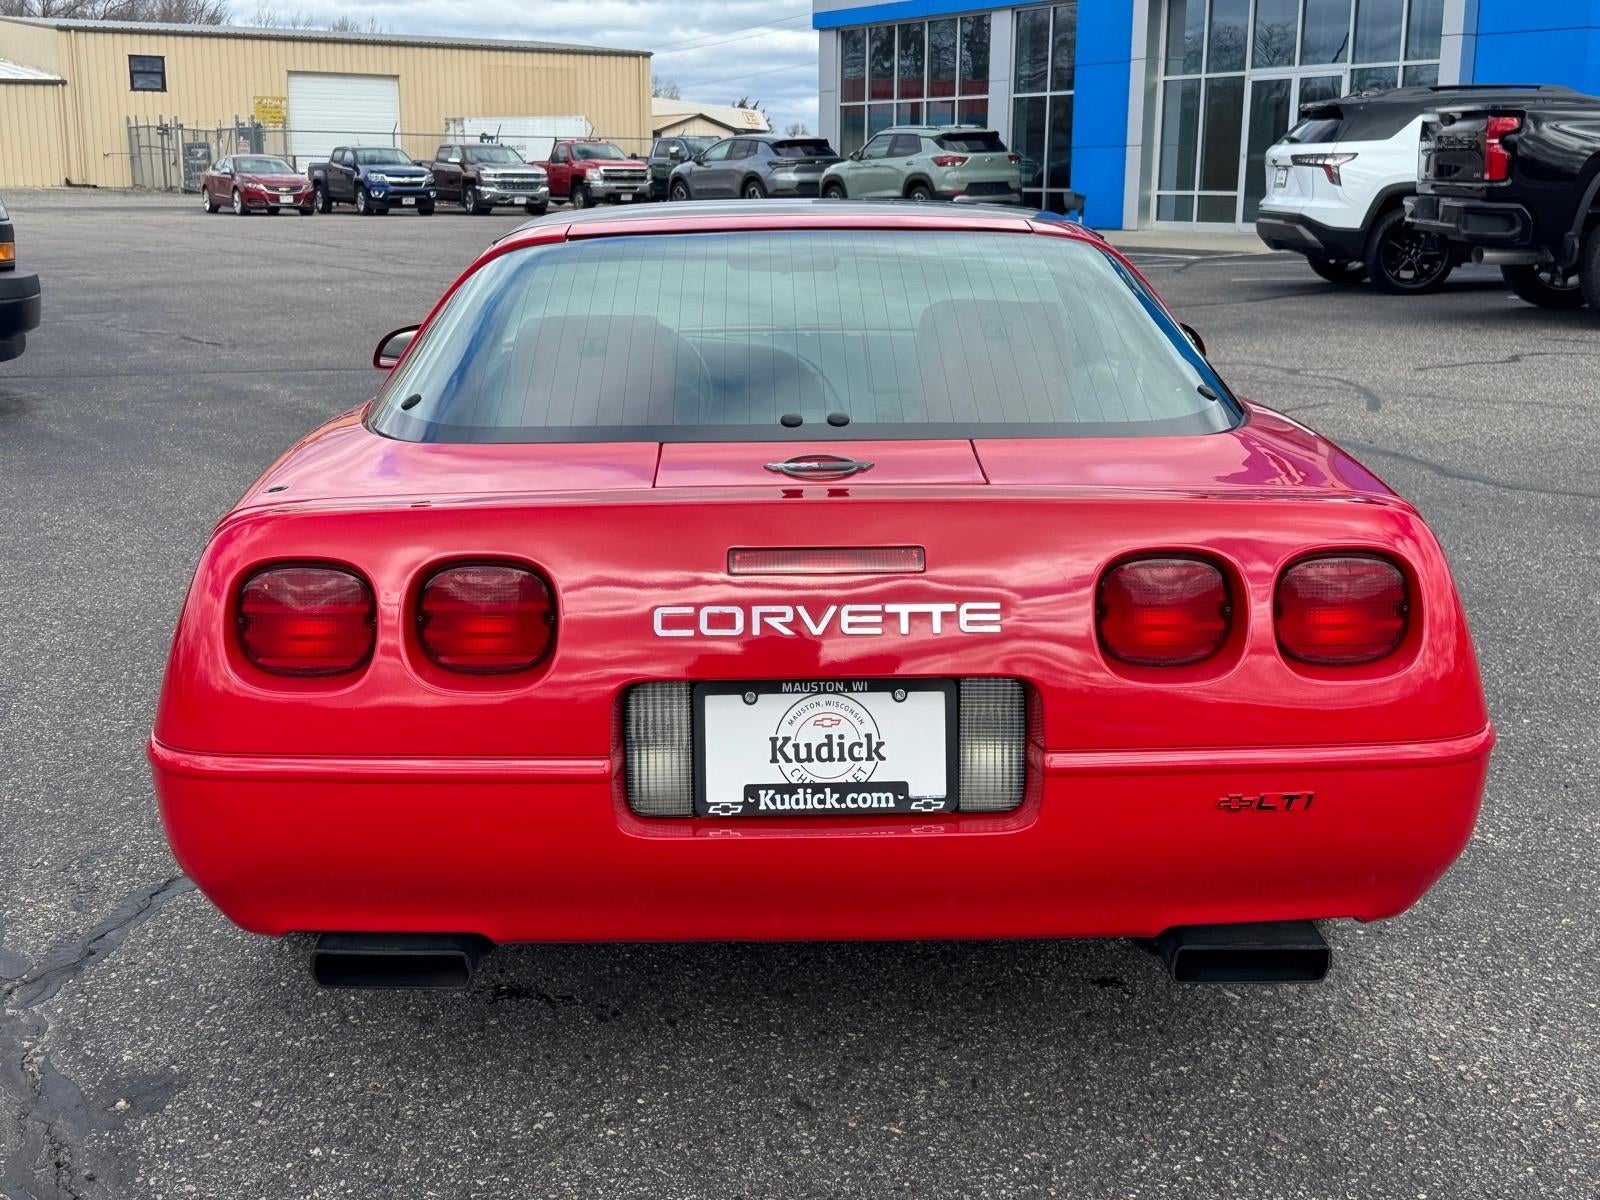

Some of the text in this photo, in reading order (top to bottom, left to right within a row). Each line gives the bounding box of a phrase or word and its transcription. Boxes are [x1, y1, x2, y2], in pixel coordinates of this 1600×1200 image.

[653, 602, 1001, 637] CORVETTE
[781, 681, 868, 693] MAUSTON, WI
[788, 700, 865, 726] MAUSTON, WISCONSIN
[768, 733, 887, 764] Kudick
[757, 788, 896, 810] Kudick.com
